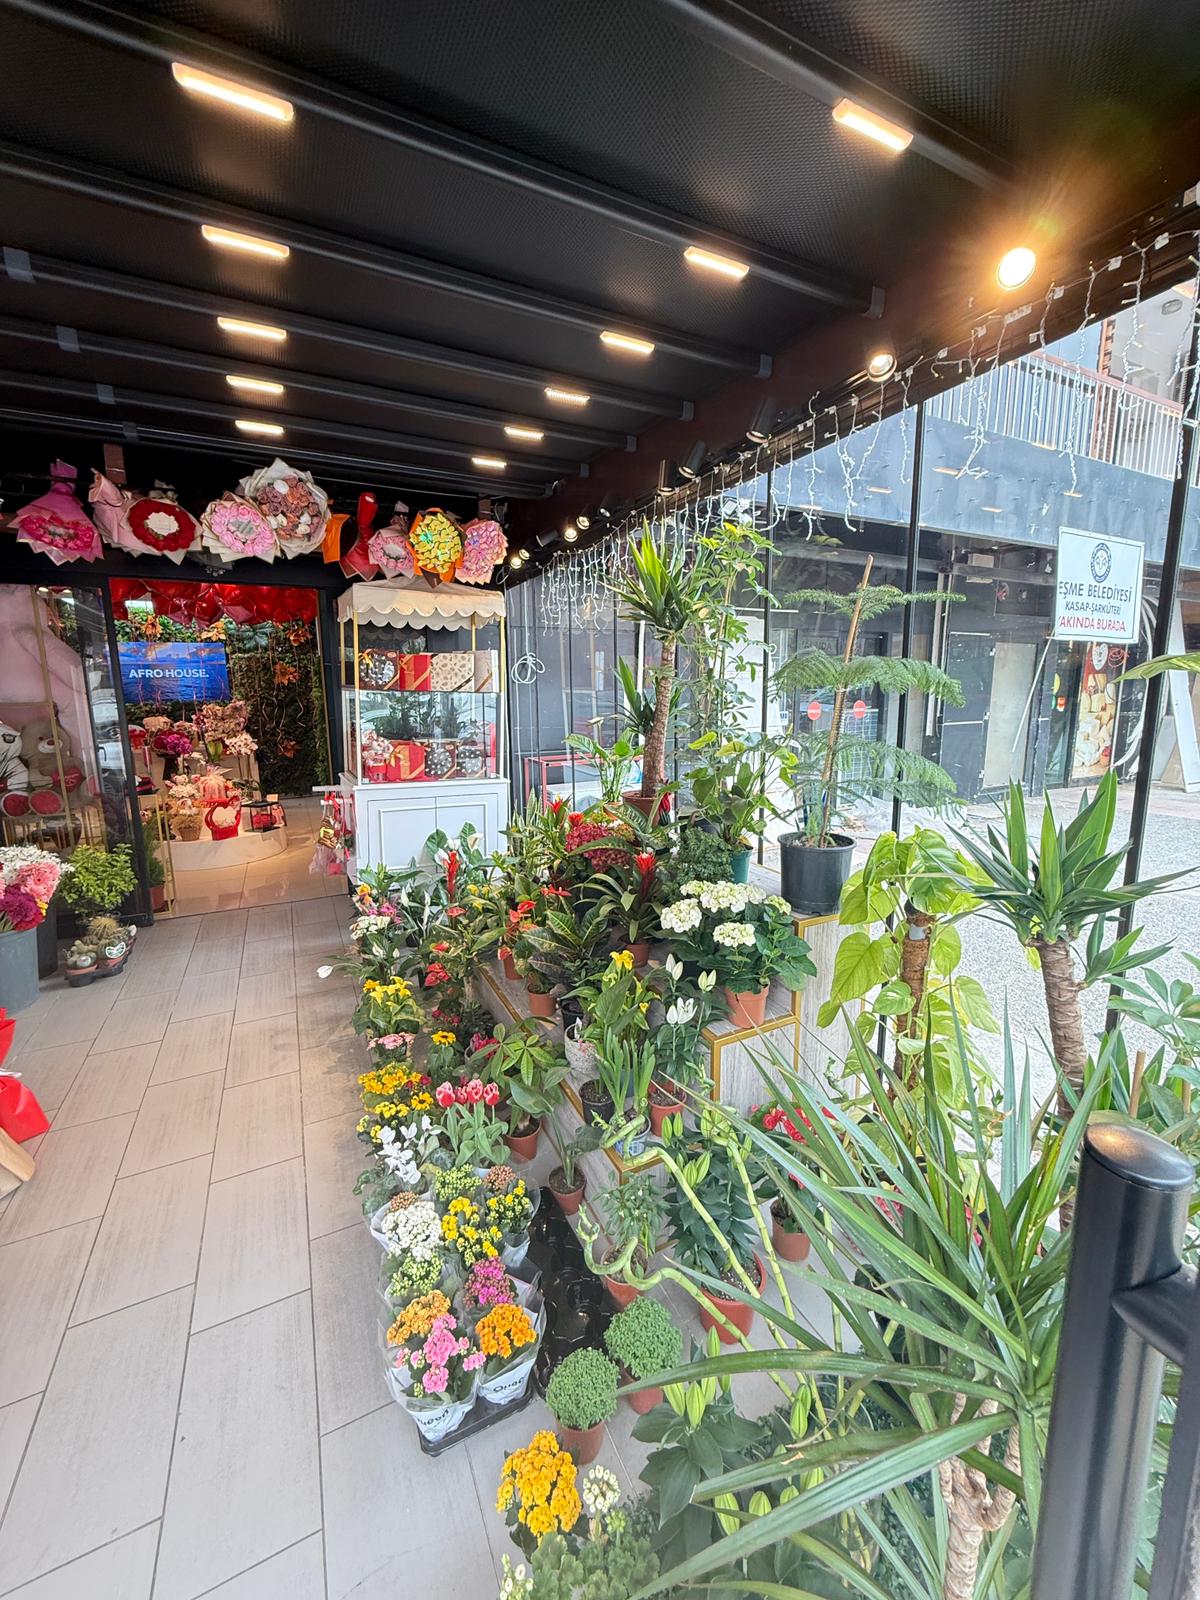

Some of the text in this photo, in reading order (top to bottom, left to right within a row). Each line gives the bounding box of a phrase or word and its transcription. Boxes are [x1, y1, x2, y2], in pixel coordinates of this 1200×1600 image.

[1088, 584, 1133, 603] BELEDİYESİ
[1096, 618, 1127, 632] BURADA
[129, 668, 210, 678] AFRO HOUSE.
